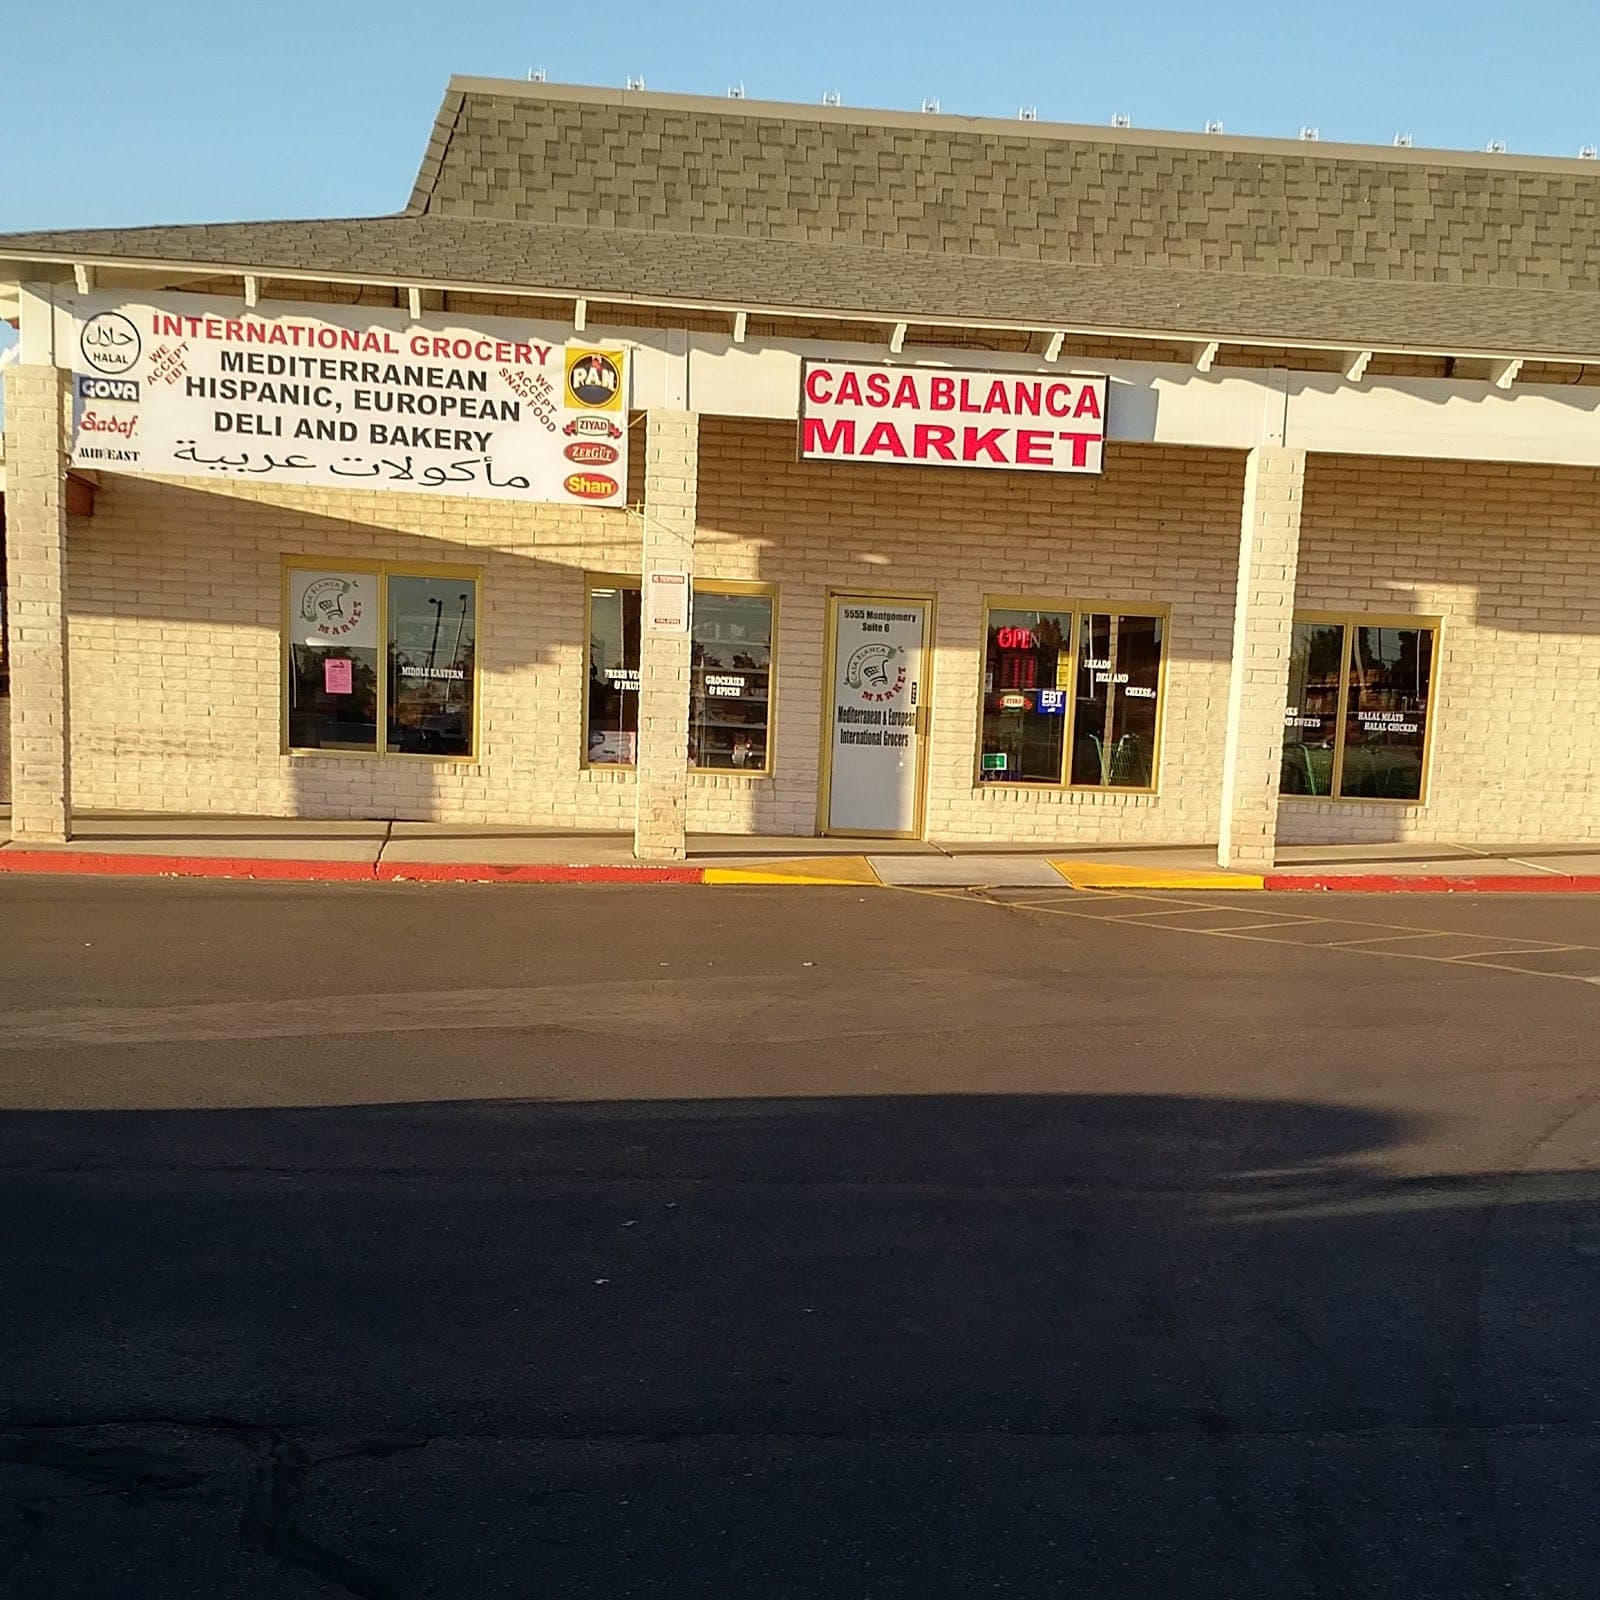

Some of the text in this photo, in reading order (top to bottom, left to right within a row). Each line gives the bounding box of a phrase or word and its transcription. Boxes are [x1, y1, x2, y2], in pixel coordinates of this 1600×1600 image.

[153, 314, 552, 366] INTERNATIONAL GROCERY
[93, 352, 128, 364] HALAL
[147, 341, 189, 385] ACCEPT
[149, 344, 170, 364] WE
[165, 361, 188, 385] EBT
[220, 351, 487, 392] MEDITERRANEAN
[82, 379, 138, 400] GOYA
[515, 371, 557, 414] ACCEPT
[536, 374, 553, 395] WE
[806, 369, 1101, 419] CASA BLANCA
[186, 376, 520, 421] HISPANIC, EUROPEAN
[499, 368, 556, 432] SNAP FOOD
[81, 411, 138, 438] Sadaf
[214, 412, 493, 452] DELI AND BAKERY
[579, 421, 607, 431] ZIYAD
[803, 418, 1102, 467] MARKET
[173, 440, 530, 489] مأكولات عربية
[568, 476, 613, 494] Shan
[318, 600, 361, 635] MARKET
[844, 609, 916, 623] 5555 Montgomery
[862, 622, 883, 632] Suite
[998, 626, 1041, 649] OPEN
[401, 666, 464, 679] MIDDLE EASTERN
[705, 675, 745, 687] GROCERIES
[1113, 673, 1128, 683] AND
[862, 667, 906, 702] MARKET
[1042, 690, 1063, 704] EBT
[838, 706, 881, 724] Mediterranean
[1358, 711, 1381, 720] HALAL
[840, 728, 882, 745] International
[1364, 722, 1387, 730] HALAL
